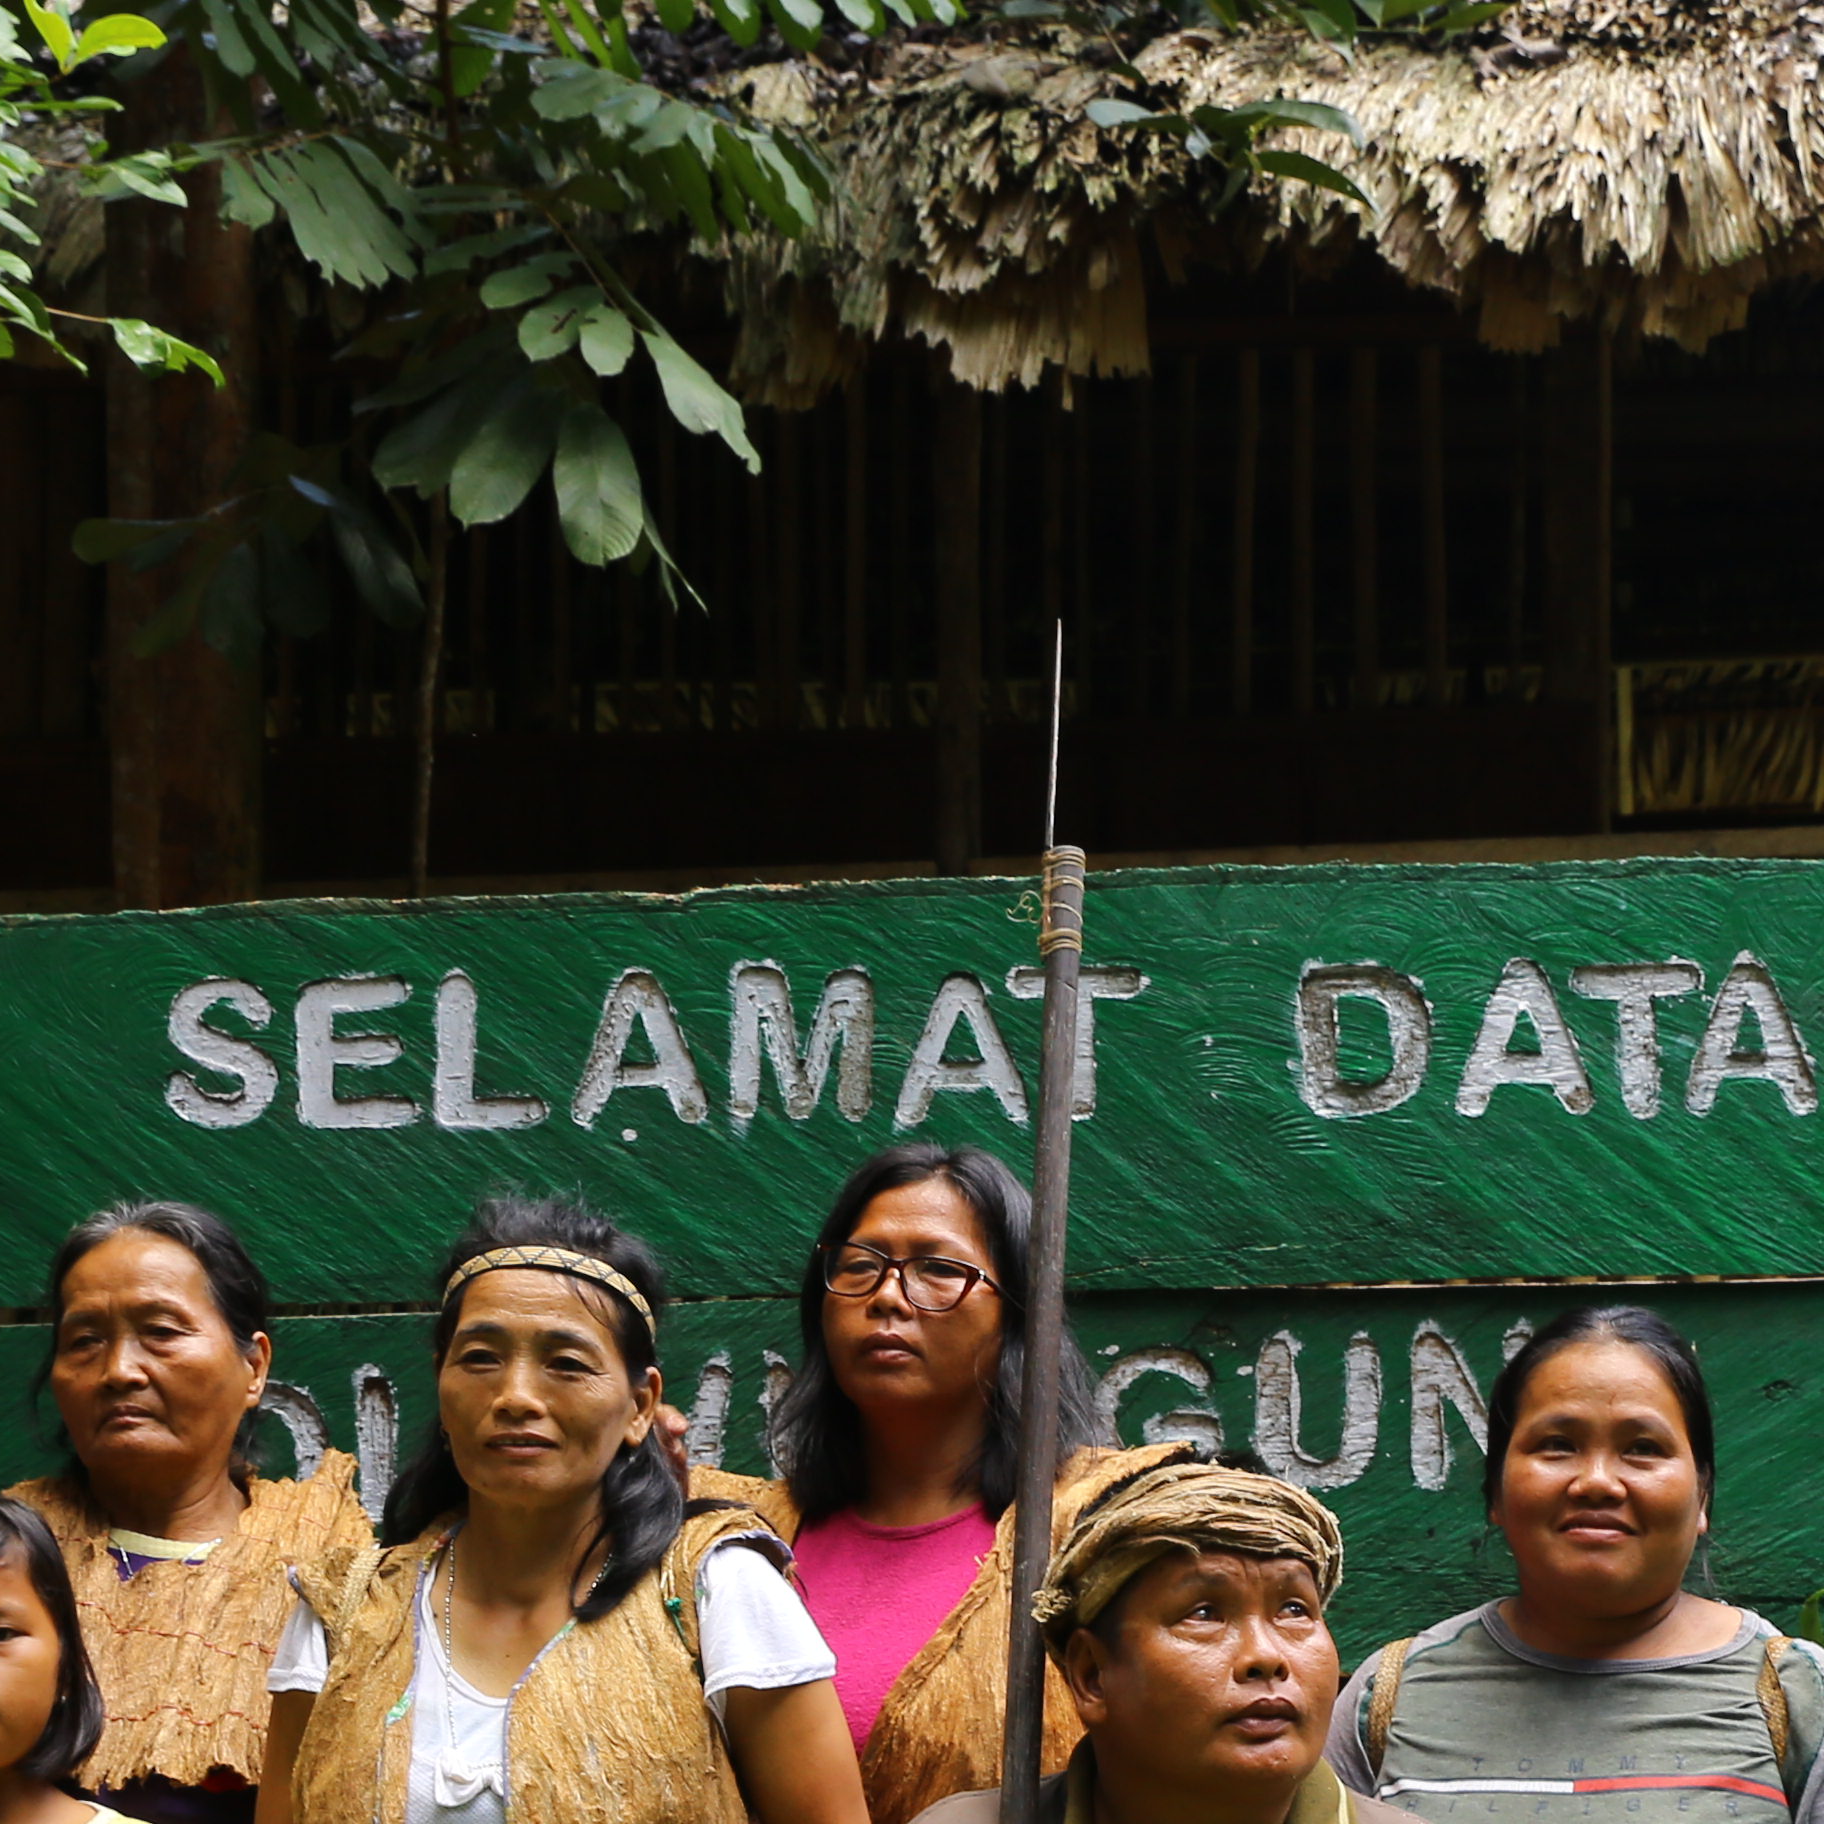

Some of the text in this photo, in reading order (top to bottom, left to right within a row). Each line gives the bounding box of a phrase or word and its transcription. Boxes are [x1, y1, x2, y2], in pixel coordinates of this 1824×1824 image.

[164, 956, 1150, 1130] SELAMAT
[1471, 1754, 1687, 1773] TOMMY
[1405, 1795, 1740, 1817] HILFIGER
